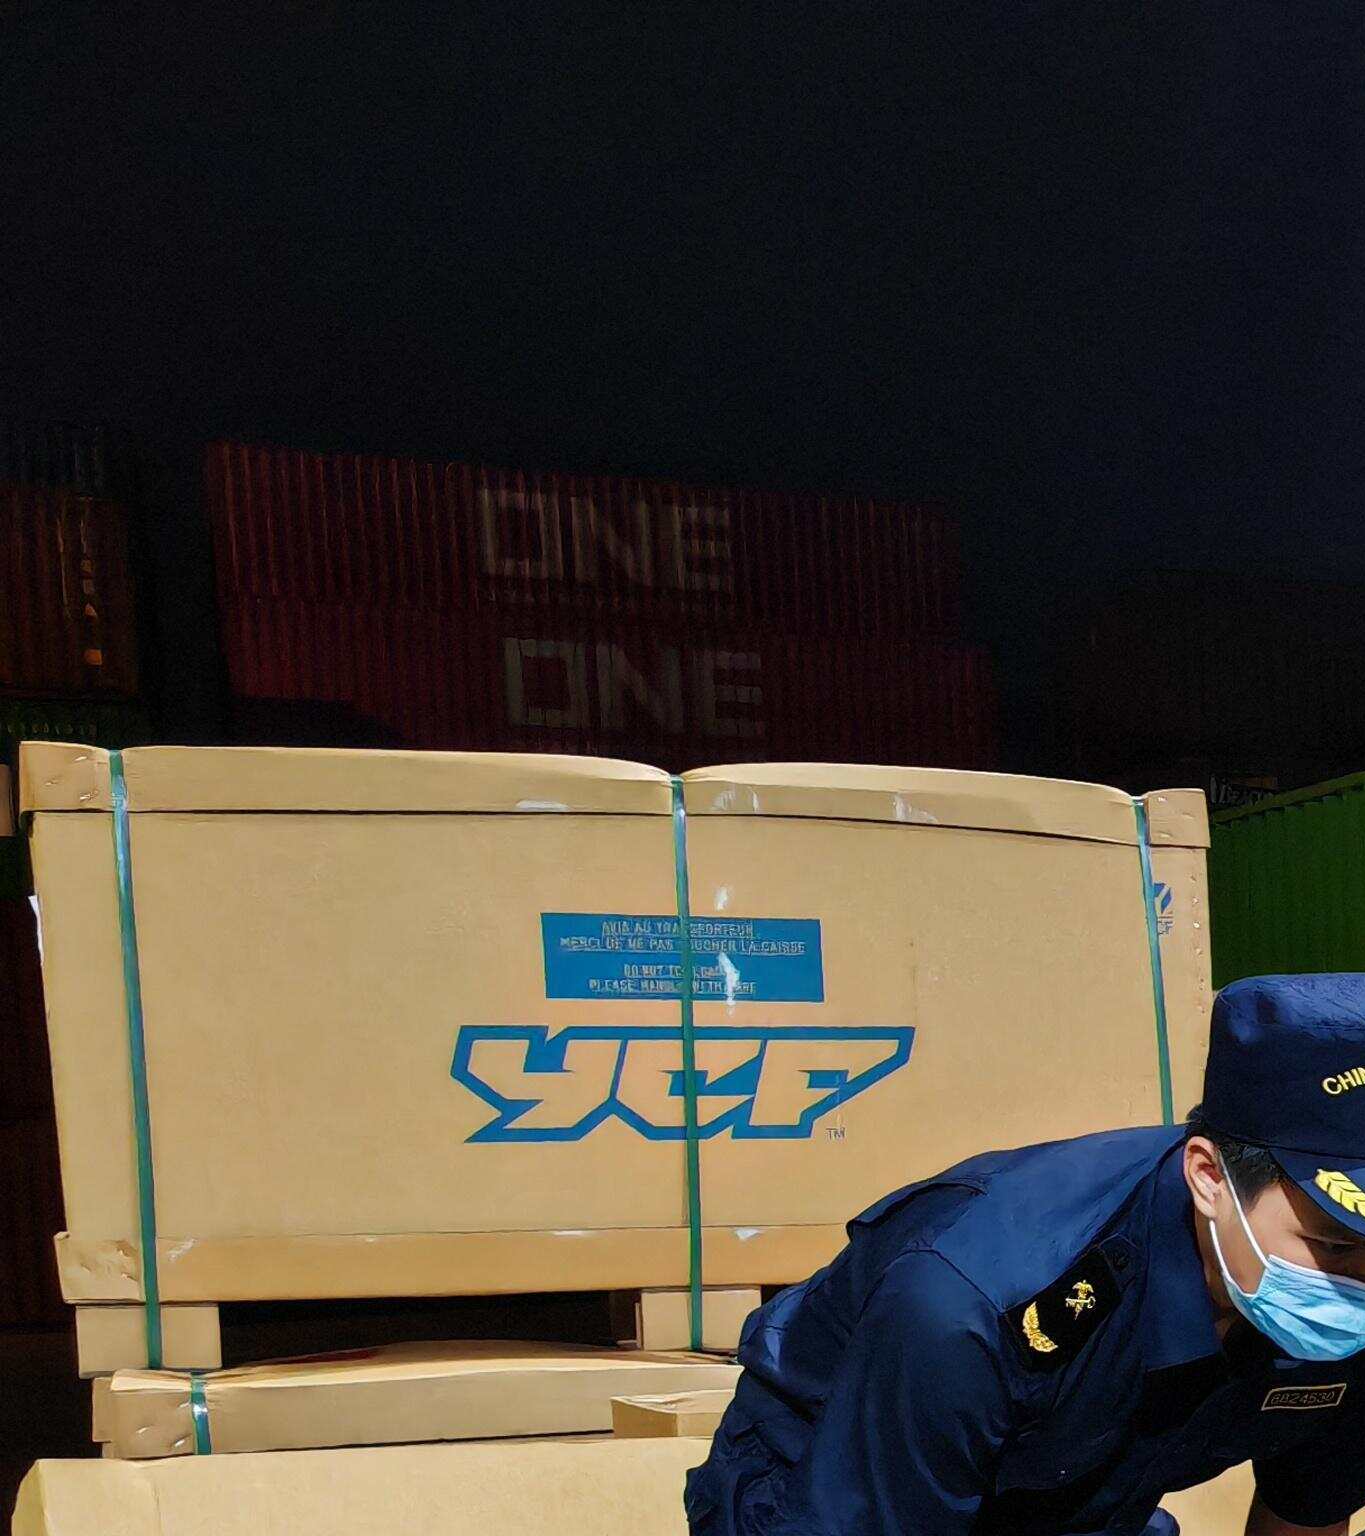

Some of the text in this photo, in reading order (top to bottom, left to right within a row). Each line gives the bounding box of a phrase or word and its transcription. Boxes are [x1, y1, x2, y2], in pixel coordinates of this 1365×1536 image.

[480, 487, 731, 592] ONE
[502, 636, 763, 738] ONE
[657, 922, 753, 938] TRASPORTEUR
[451, 1025, 916, 1143] YCF
